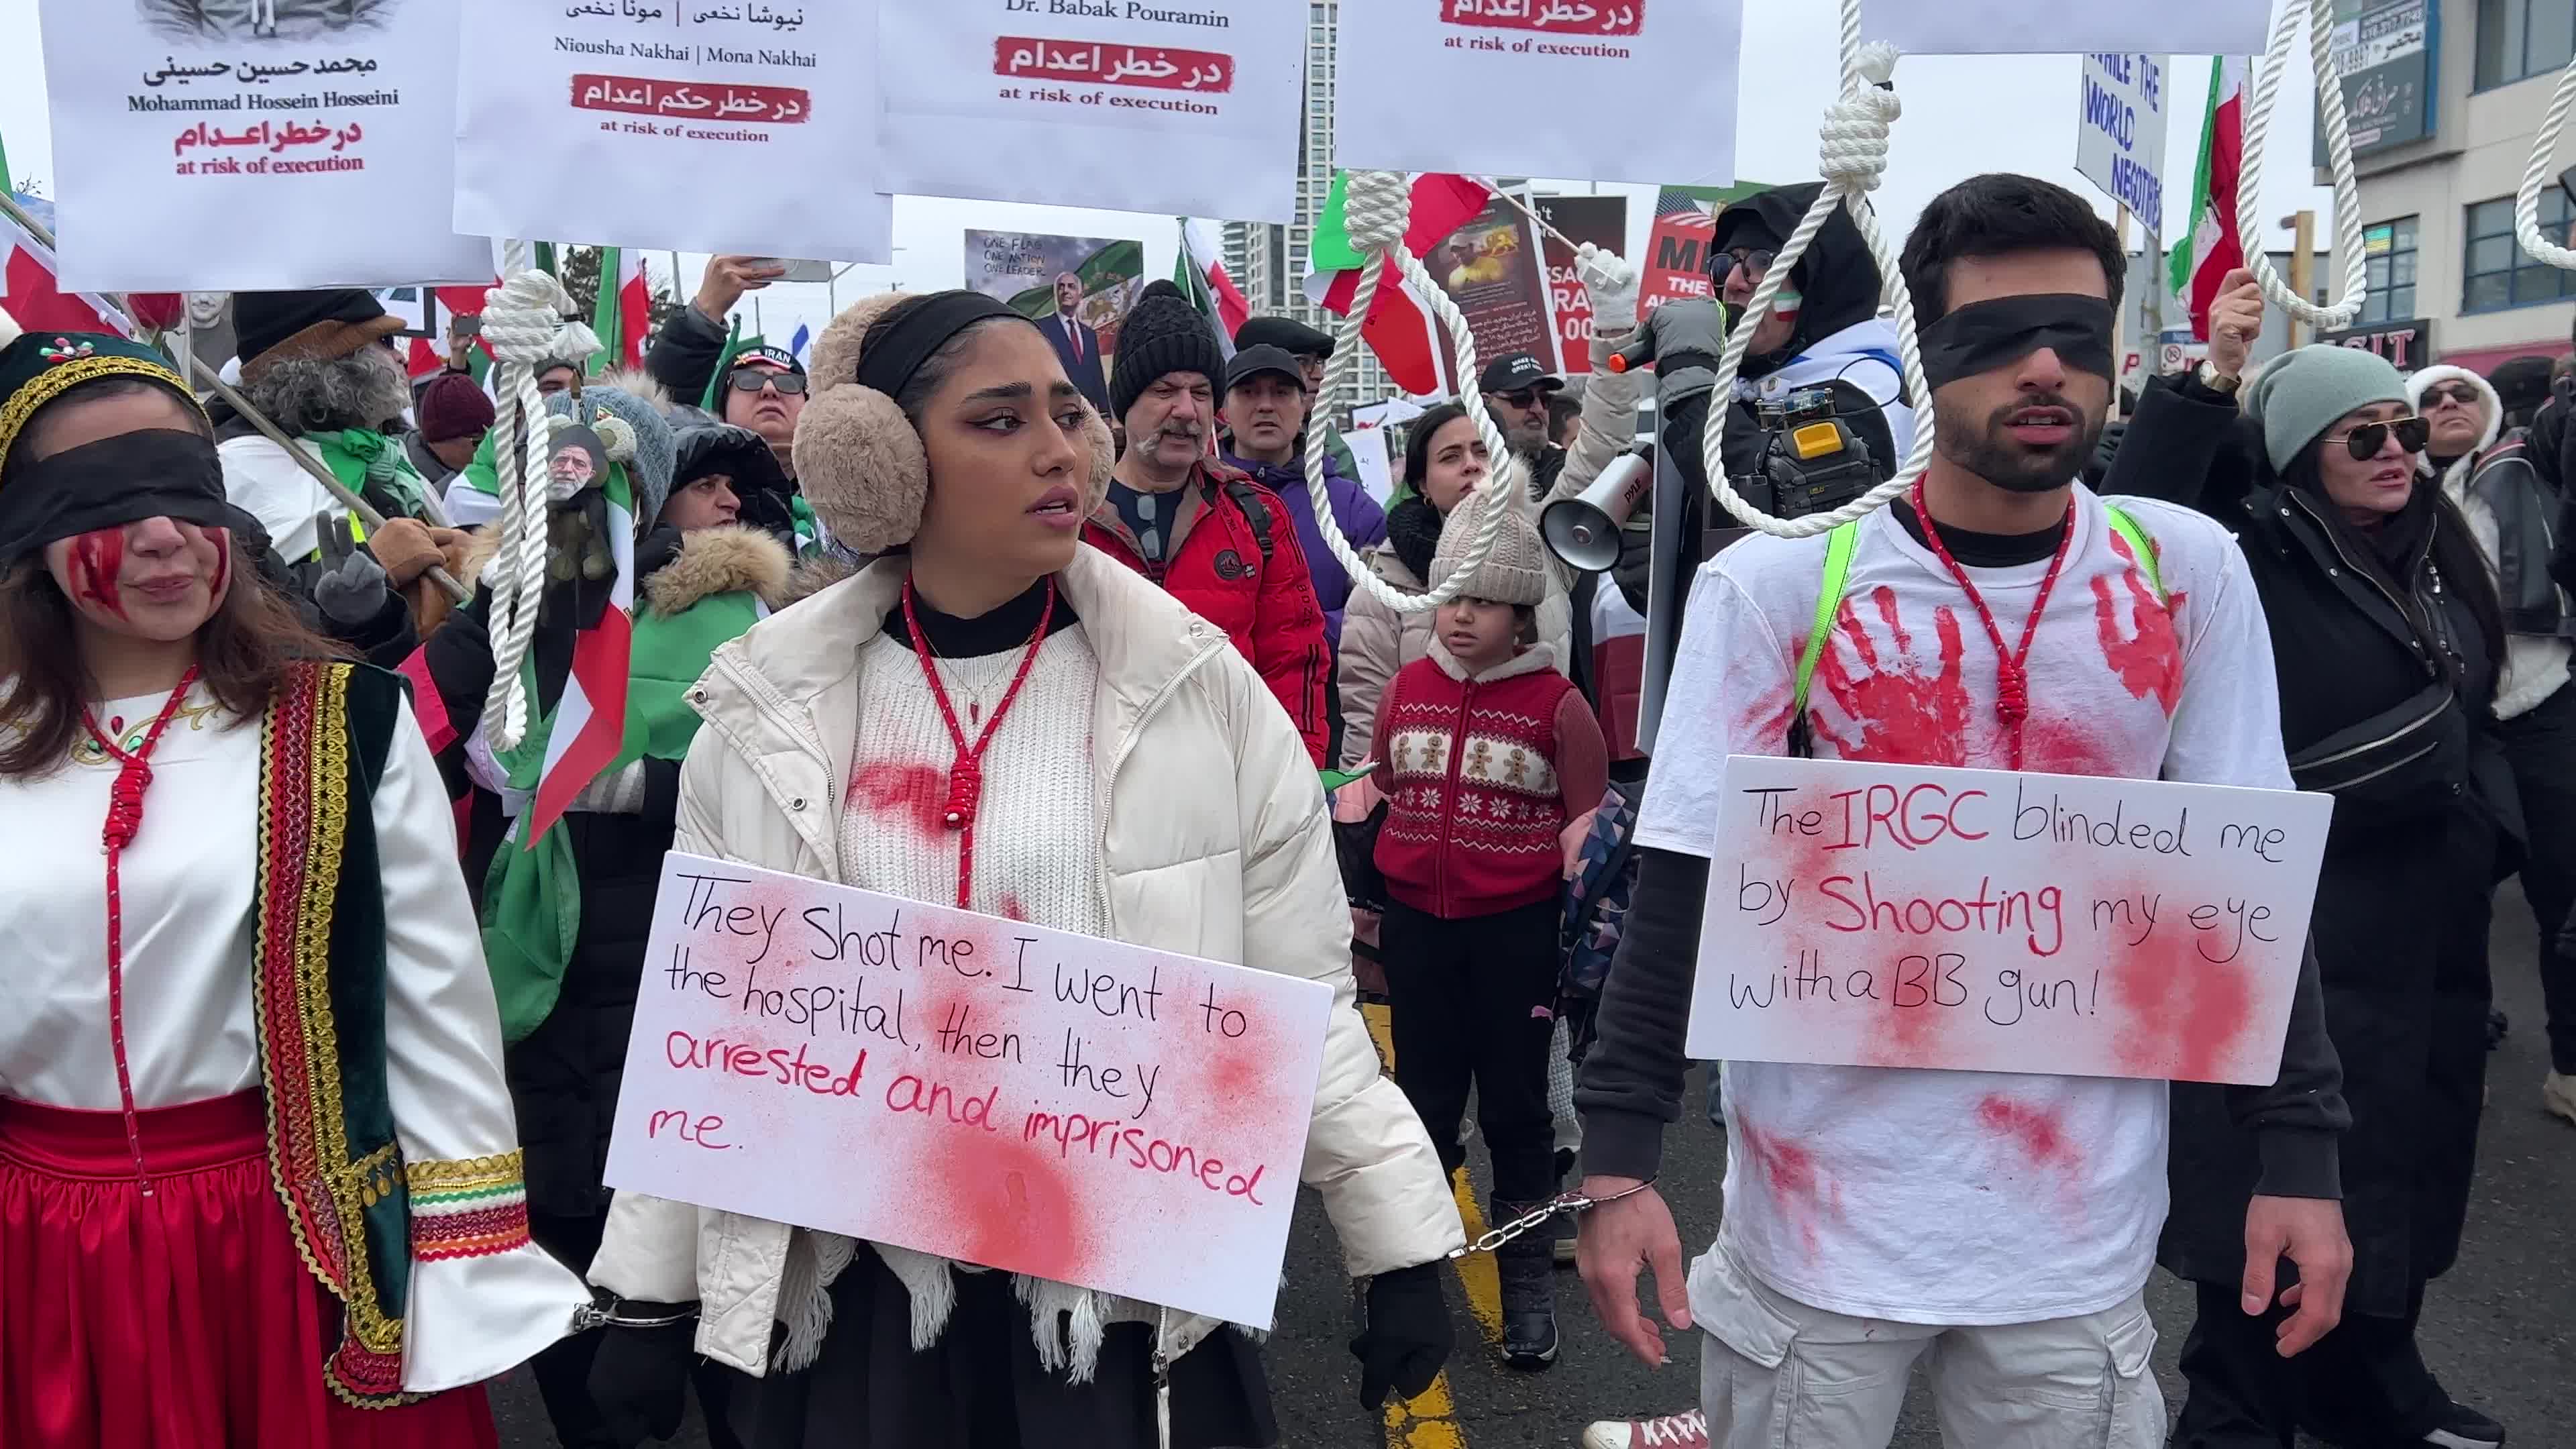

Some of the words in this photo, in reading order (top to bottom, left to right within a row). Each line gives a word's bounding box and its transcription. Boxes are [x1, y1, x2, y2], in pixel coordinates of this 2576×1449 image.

[566, 2, 615, 17] نخعی
[623, 0, 662, 23] مونا
[692, 7, 741, 23] نخعی
[748, 2, 804, 32] نیوشا
[1006, 0, 1039, 12] Dr.
[1049, 0, 1118, 18] Babak
[1126, 1, 1230, 28] Pouramin
[1454, 0, 1529, 18] اعدام
[1533, 0, 1598, 26] خطر
[1601, 5, 1633, 30] در
[553, 36, 625, 56] Niousha
[630, 43, 690, 62] Nakhai
[706, 47, 753, 64] Mona
[759, 50, 816, 68] Nakhai
[1009, 42, 1101, 72] اعدام
[1444, 37, 1462, 48] at
[1469, 36, 1505, 51] risk
[1512, 39, 1533, 52] of
[1537, 43, 1630, 59] execution
[144, 56, 231, 86] حسینی
[237, 60, 311, 84] حسین
[314, 56, 377, 77] محمد
[1103, 49, 1179, 82] خطر
[1181, 62, 1222, 88] در
[584, 80, 653, 105] اعدام
[2090, 54, 2131, 85] HILE
[2139, 54, 2159, 113] THE
[128, 94, 241, 112] Mohammad
[248, 93, 318, 109] Hossein
[323, 89, 399, 108] Hosseini
[658, 88, 712, 113] حکم
[714, 90, 768, 117] خطر
[771, 99, 800, 119] در
[1000, 89, 1021, 99] at
[1030, 89, 1072, 103] risk
[1079, 92, 1104, 105] of
[1110, 97, 1218, 115] execution
[2086, 74, 2135, 152] WORLD
[174, 120, 269, 155] اعدام
[270, 119, 331, 152] خطر
[331, 121, 362, 151] در
[600, 121, 617, 131] at
[623, 121, 658, 135] risk
[663, 125, 683, 137] of
[687, 129, 769, 142] execution
[176, 159, 195, 174] at
[202, 156, 241, 174] risk
[246, 156, 268, 174] of
[272, 155, 365, 174] execution
[983, 237, 1005, 248] ONE
[1011, 238, 1042, 251] FLAG
[984, 250, 1004, 261] ONE
[1009, 253, 1046, 264] NATION
[984, 263, 1004, 273] ONE
[1668, 276, 1708, 294] THE
[764, 348, 791, 364] IRAN
[1511, 357, 1529, 366] MAKE
[1511, 363, 1531, 374] GREAT
[1624, 478, 1642, 504] PYLE
[1742, 787, 1823, 837] The
[1822, 782, 1990, 852] IRGC
[2014, 778, 2192, 857] blinded
[2220, 823, 2287, 864] me
[1738, 863, 1795, 926] by
[1819, 870, 2064, 957] Shooting
[2093, 893, 2162, 947] my
[2186, 900, 2279, 964] eye
[677, 871, 787, 963] They
[804, 900, 903, 972] Shot
[918, 930, 992, 979] me.
[1002, 936, 1039, 994] I
[1055, 963, 1163, 1023] went
[1199, 981, 1248, 1039] to
[1729, 949, 1841, 1010] with
[1845, 971, 1882, 1002] a
[1892, 951, 1969, 1010] BB
[1984, 969, 2102, 1027] gun!
[664, 945, 727, 1000] the
[743, 966, 921, 1053] hospital,
[936, 1000, 1022, 1065] then
[1056, 1029, 1161, 1120] they
[648, 1107, 745, 1152] me.
[665, 1029, 867, 1099] arrested
[886, 1074, 1000, 1133] and
[1025, 1101, 1266, 1207] imprisoned
